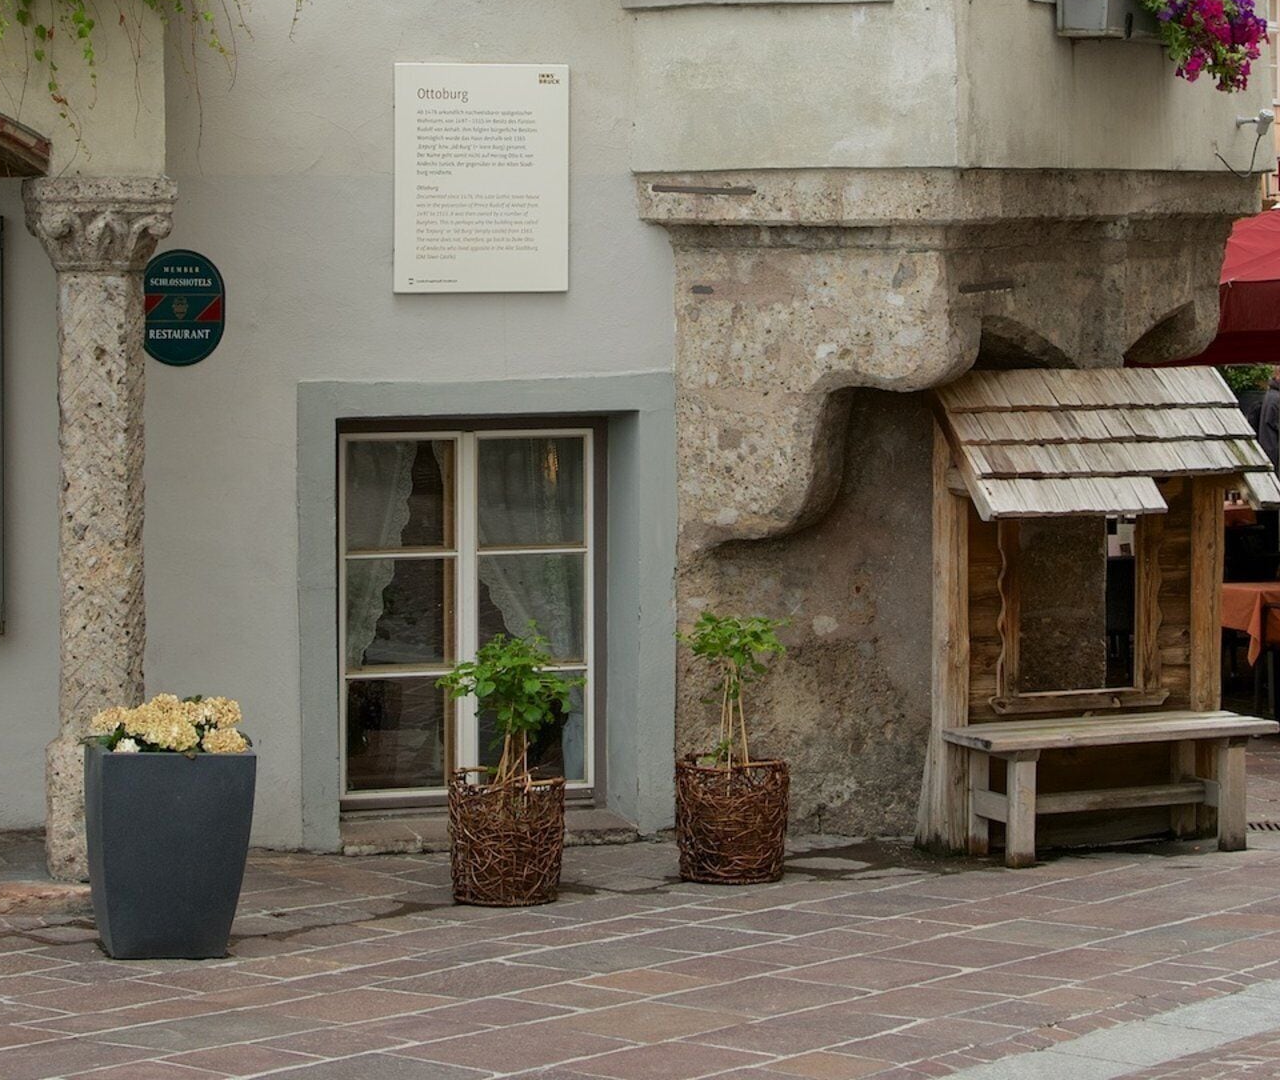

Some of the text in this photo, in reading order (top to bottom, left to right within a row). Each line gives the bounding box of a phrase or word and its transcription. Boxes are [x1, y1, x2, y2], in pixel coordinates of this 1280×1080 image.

[417, 88, 469, 103] Ottoburg
[150, 278, 213, 287] SCHLOSSHOTELS
[149, 329, 211, 339] RESTAURANT
